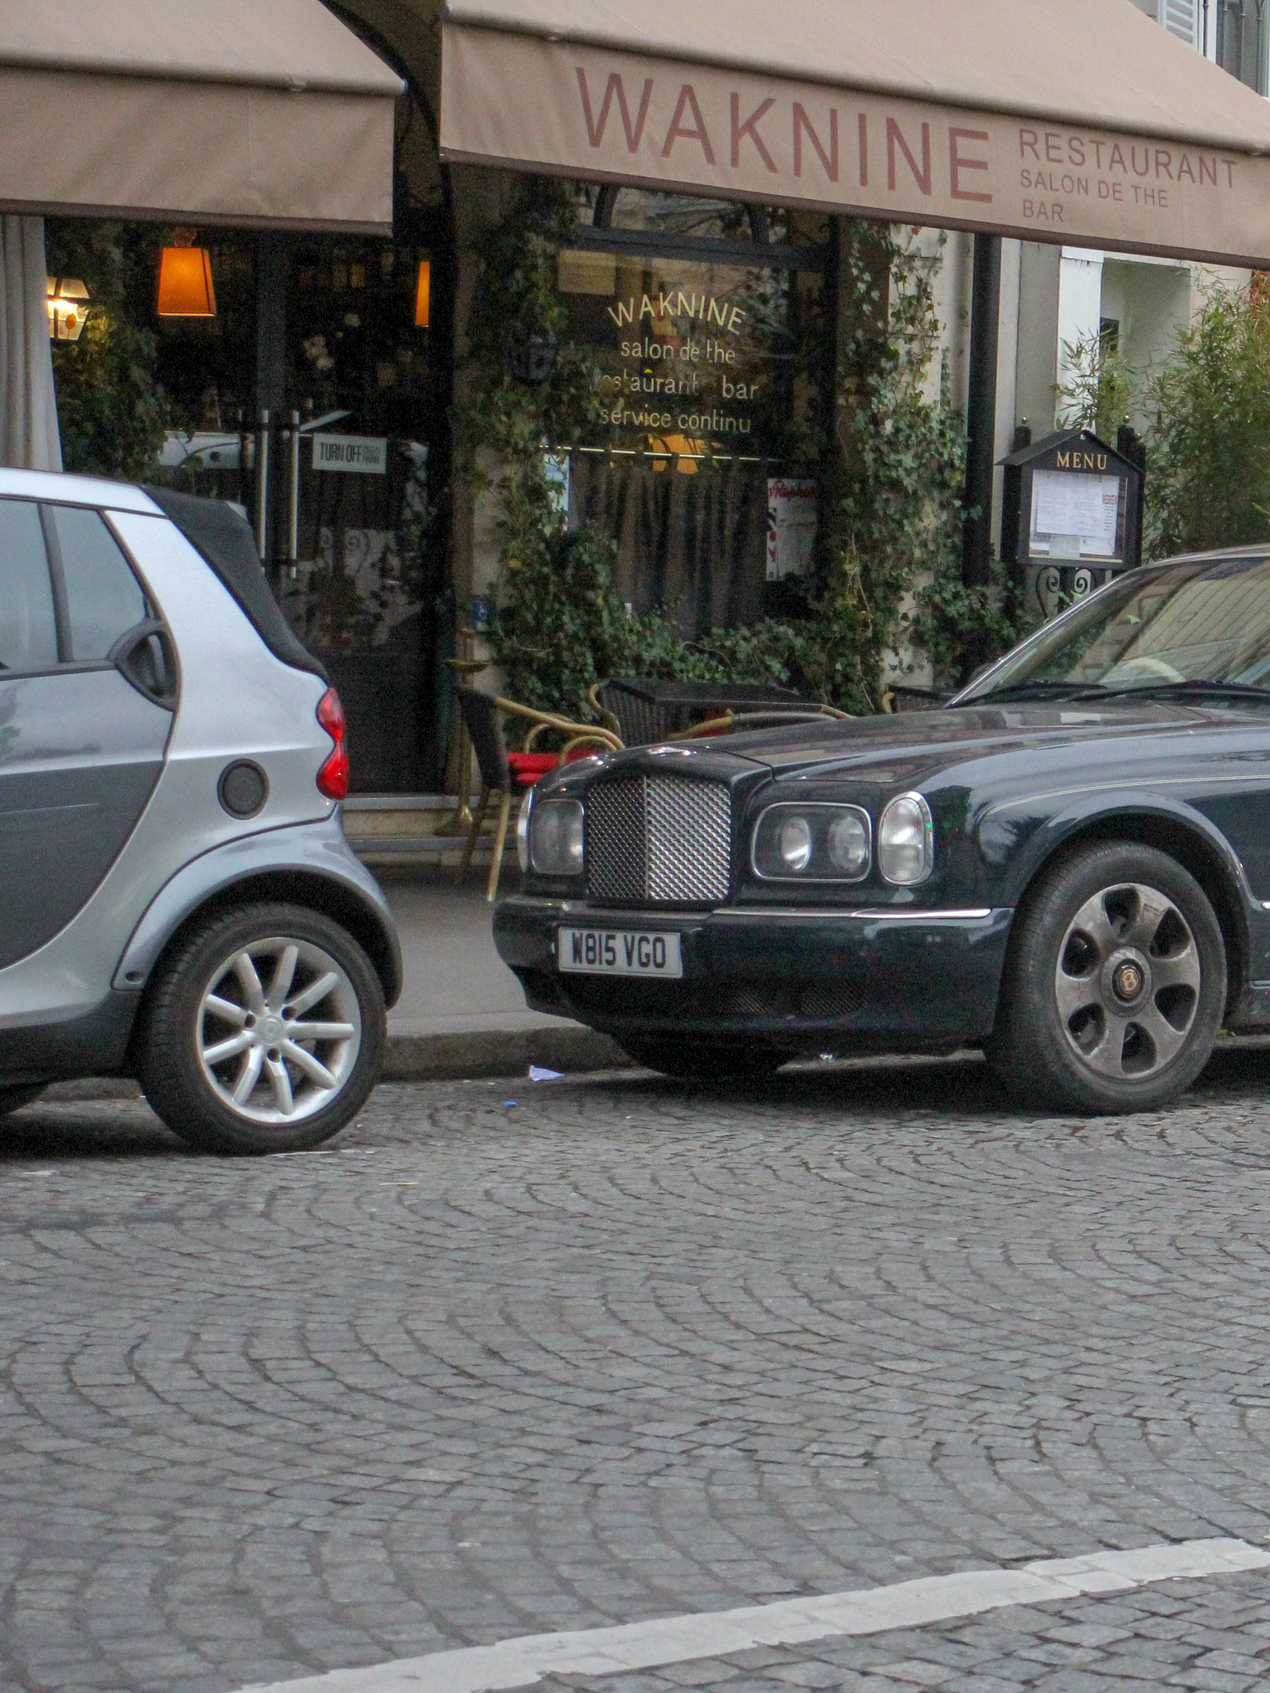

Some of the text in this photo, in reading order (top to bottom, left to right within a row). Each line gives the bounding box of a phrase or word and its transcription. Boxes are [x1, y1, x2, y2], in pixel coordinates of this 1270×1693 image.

[575, 67, 992, 203] WAKNINE
[1019, 128, 1237, 188] RESTAURANT
[1021, 169, 1169, 208] SALON DE THE
[1022, 200, 1064, 222] BAR
[608, 292, 747, 335] WAKNINE
[621, 337, 736, 364] salon de the
[722, 375, 759, 399] bar
[600, 404, 751, 432] service continu
[320, 443, 344, 461] TURN
[346, 444, 362, 462] OFF
[1056, 451, 1108, 470] MENU
[571, 932, 666, 969] W815 VGO
